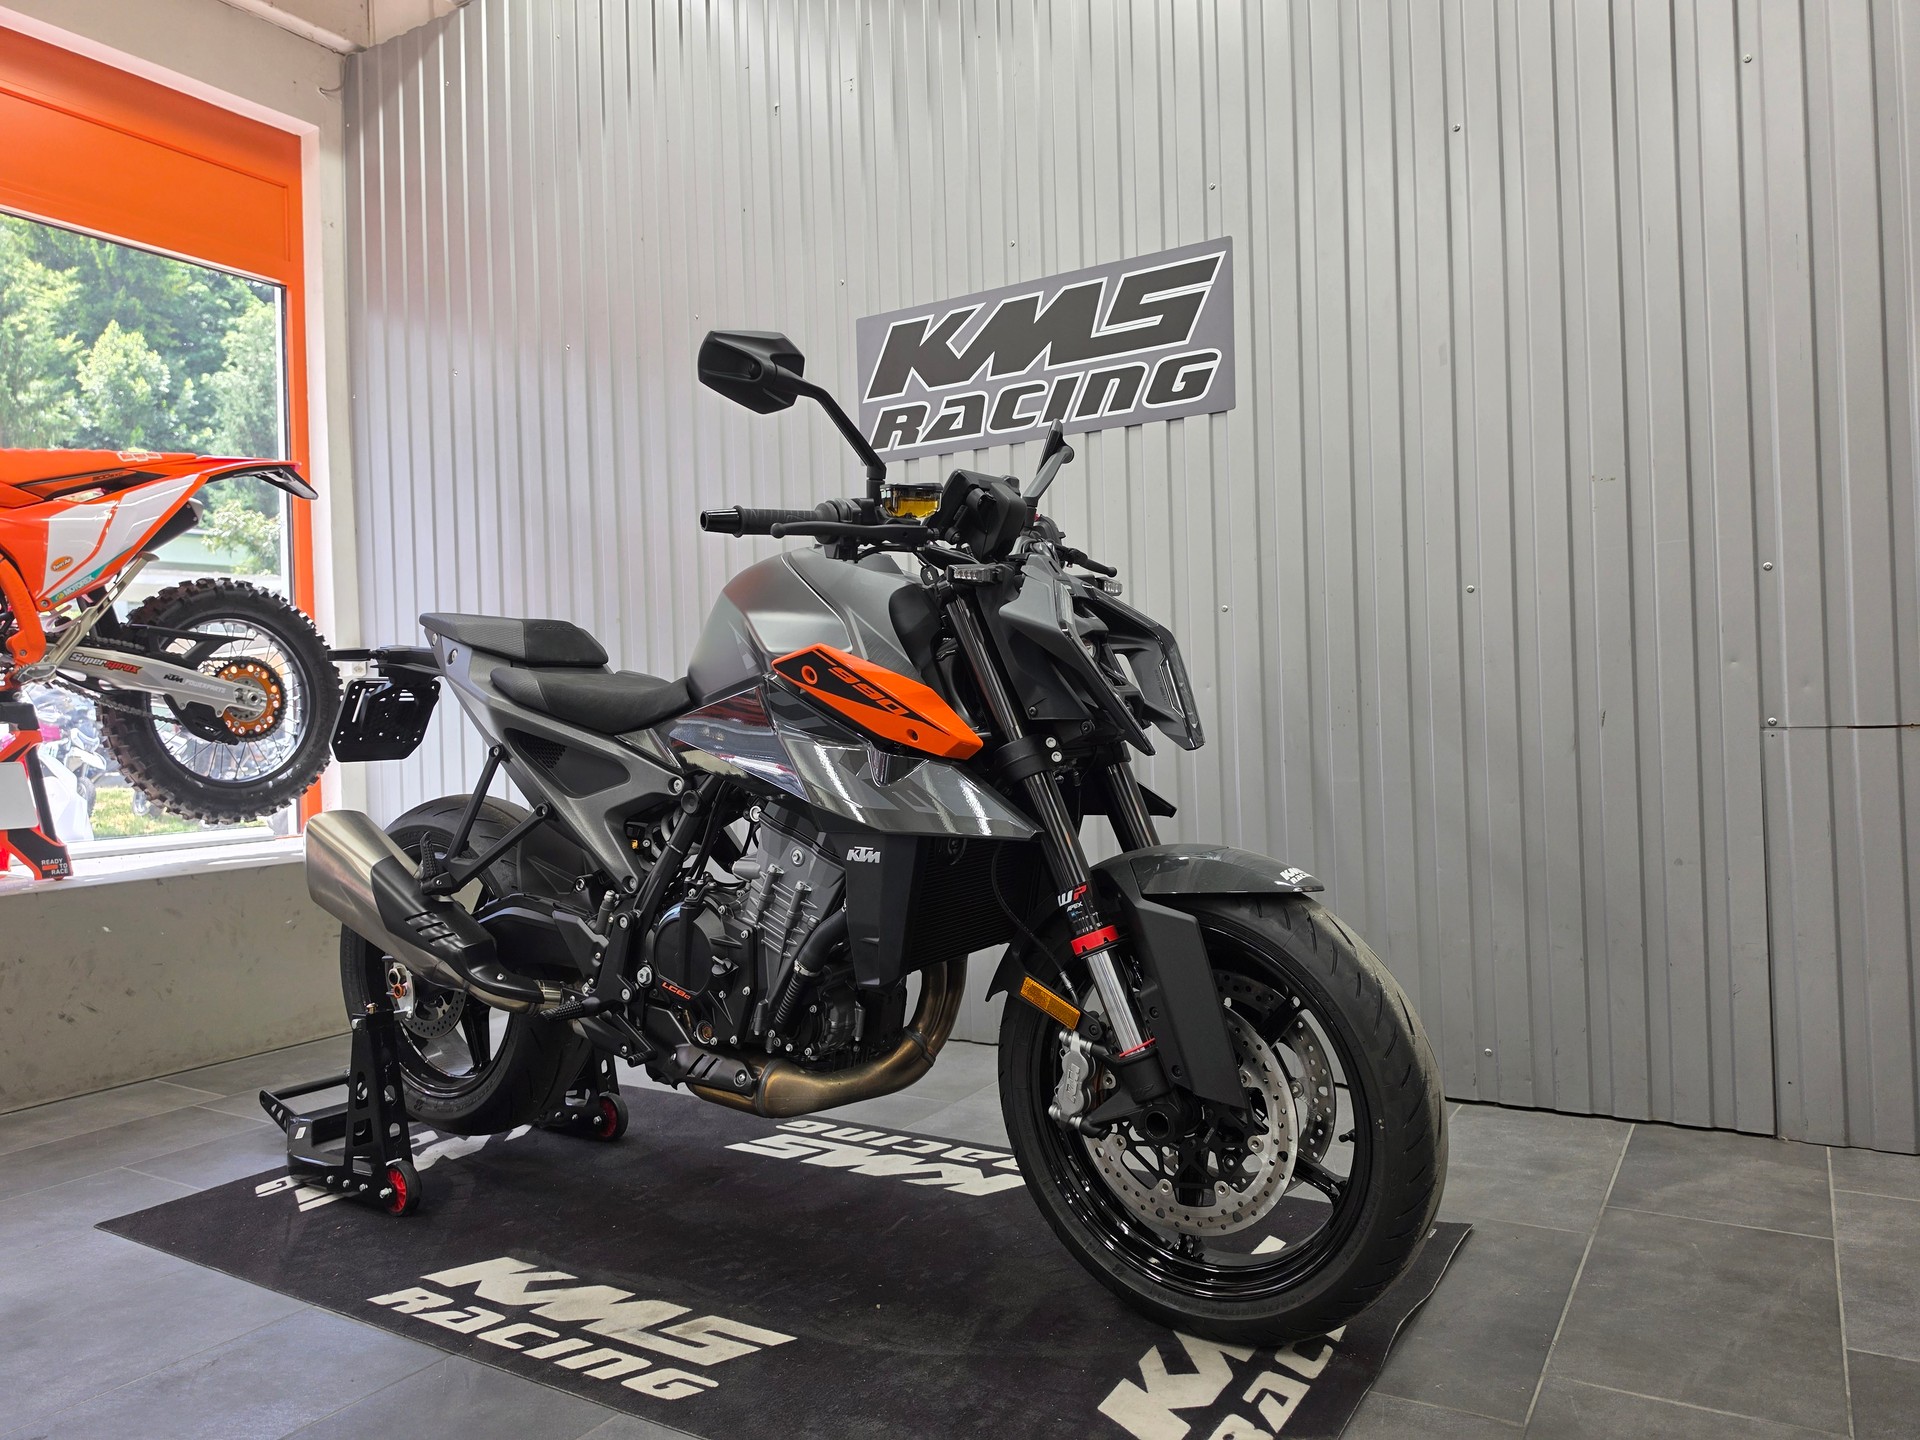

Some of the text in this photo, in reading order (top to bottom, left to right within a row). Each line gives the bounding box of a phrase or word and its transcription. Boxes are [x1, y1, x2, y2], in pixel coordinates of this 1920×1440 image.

[863, 251, 1226, 403] KMS
[869, 348, 1222, 453] RACING
[64, 574, 95, 596] MOTOREX
[69, 652, 142, 674] Supersprox
[163, 673, 184, 684] KTM
[828, 666, 909, 716] 990
[846, 846, 881, 863] KTM
[1058, 885, 1087, 907] WP
[1067, 901, 1083, 912] APEX
[724, 1134, 1026, 1196] KMS
[420, 1257, 798, 1365] KMS
[367, 1287, 719, 1400] RACING
